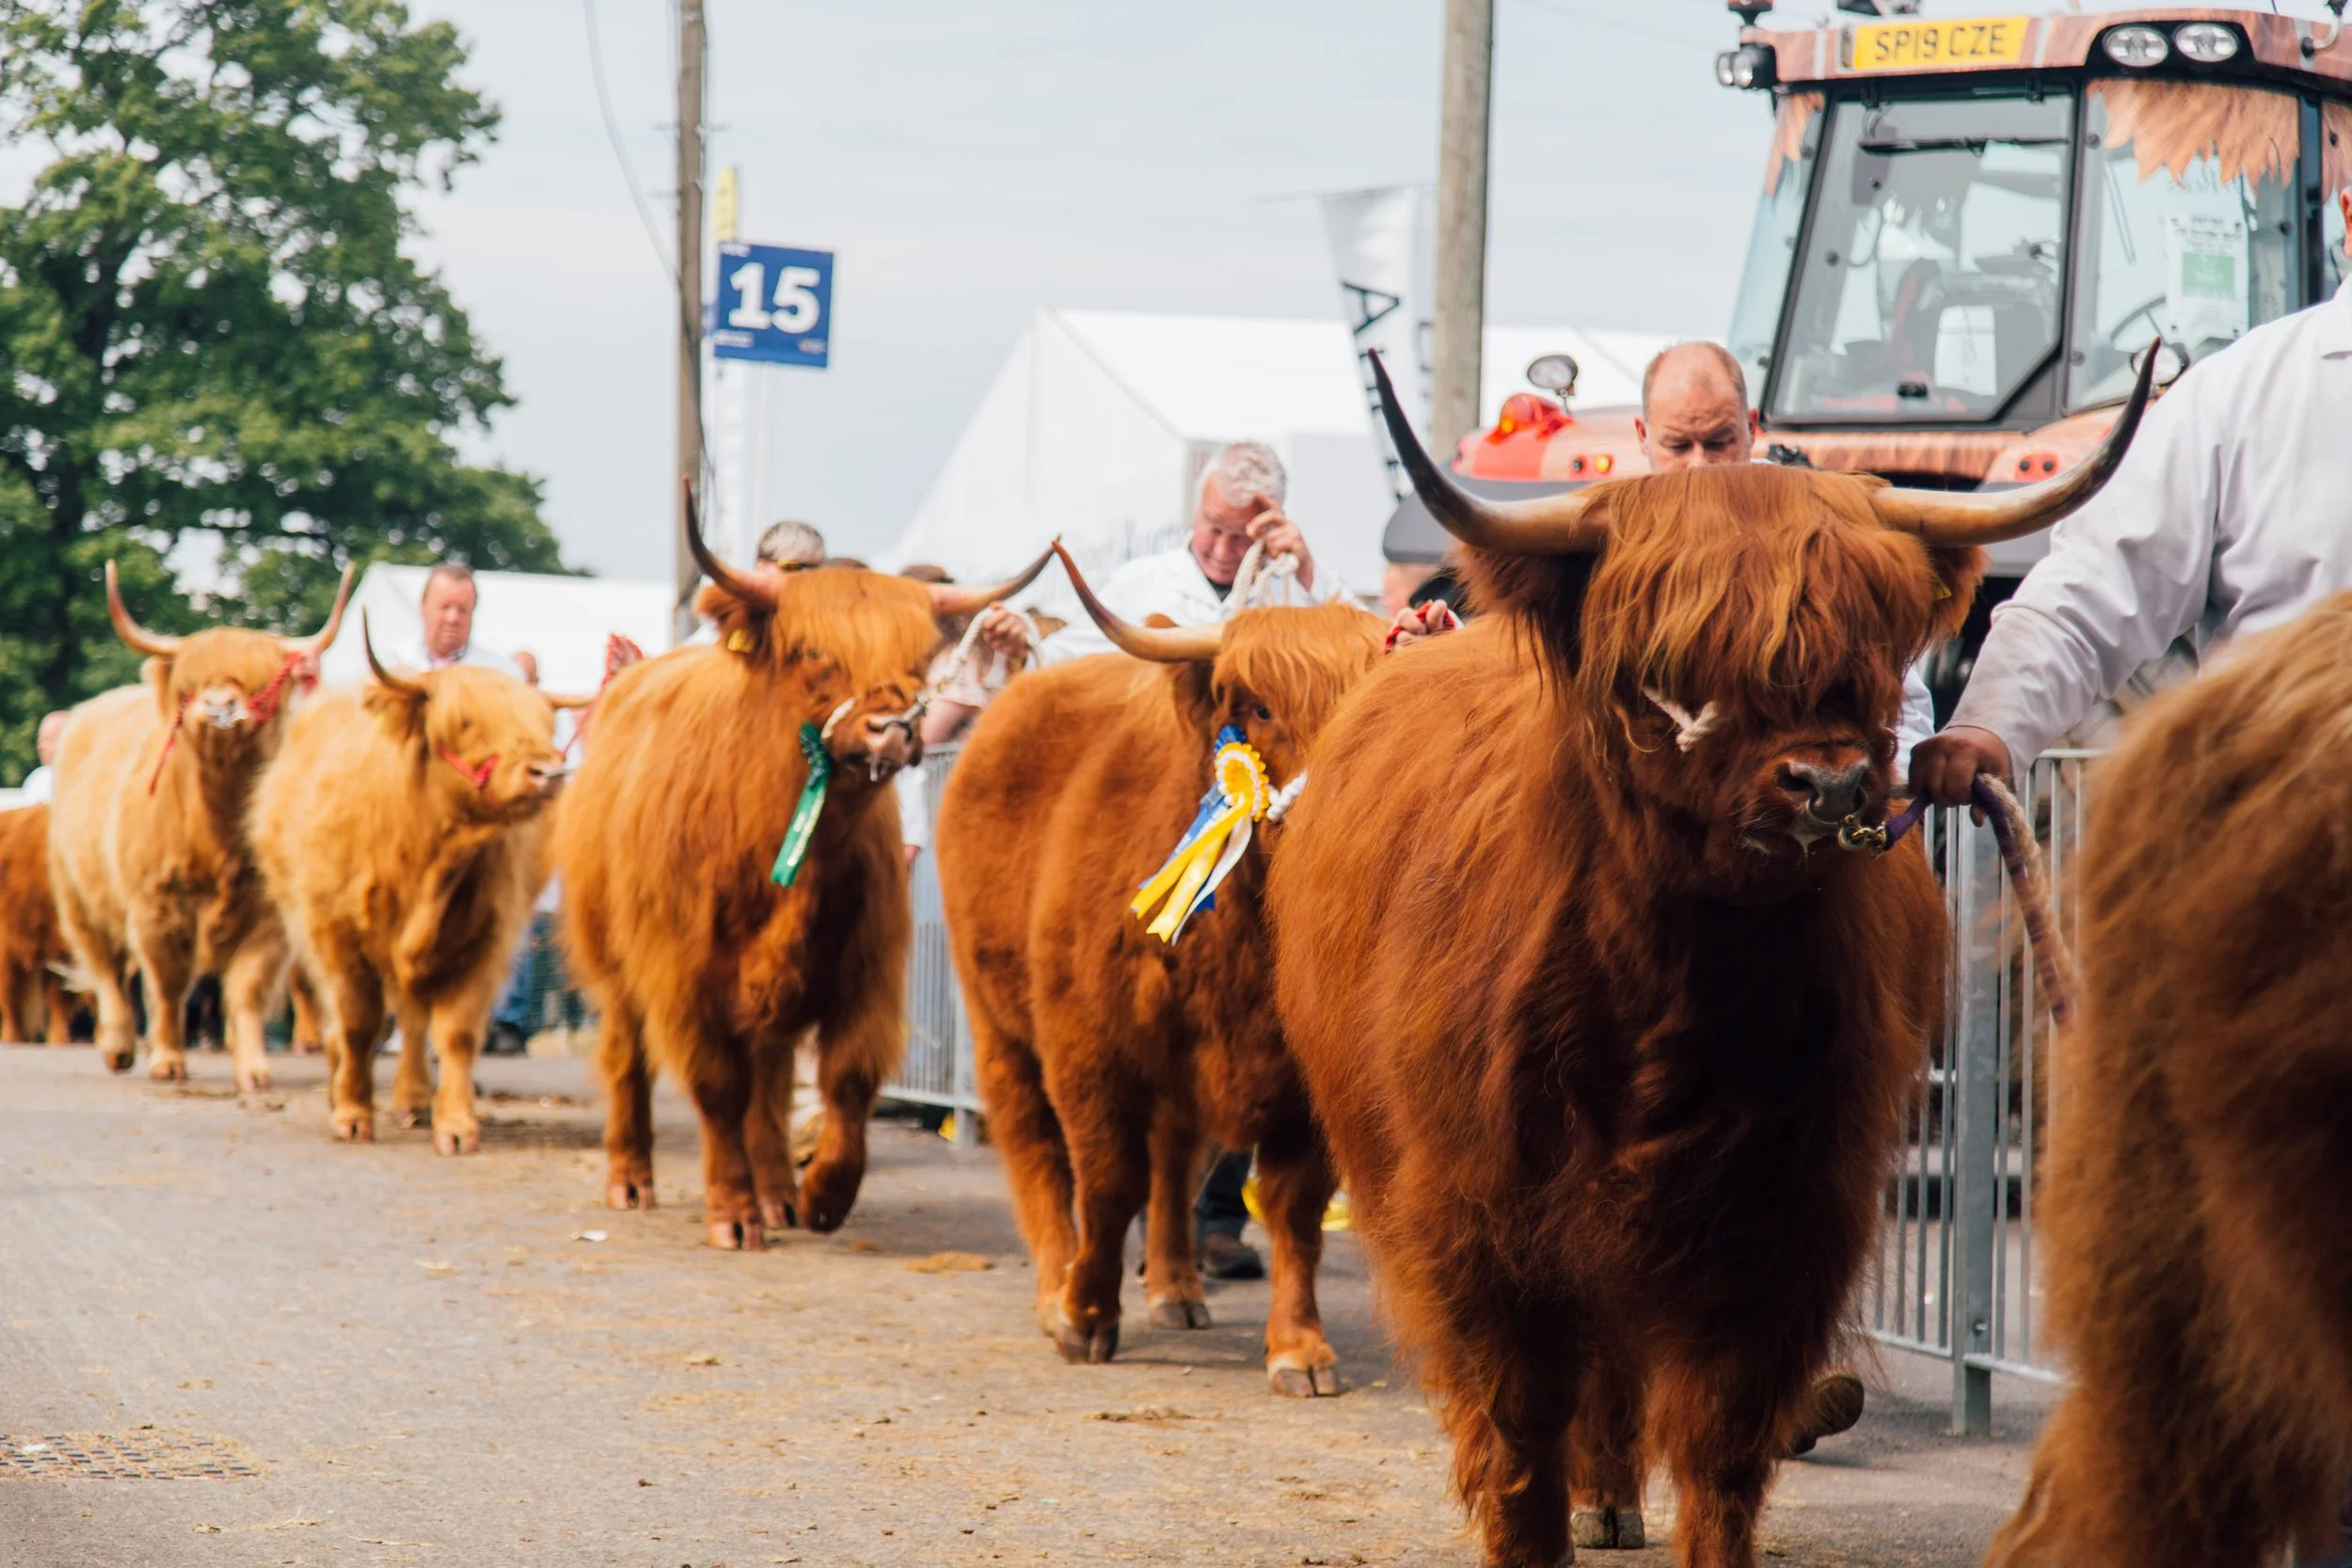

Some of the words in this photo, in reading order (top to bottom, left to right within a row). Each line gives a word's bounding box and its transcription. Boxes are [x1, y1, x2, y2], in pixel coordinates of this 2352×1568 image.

[1875, 28, 1938, 61] SP19
[1949, 24, 2007, 56] CZE
[728, 261, 821, 334] 15
